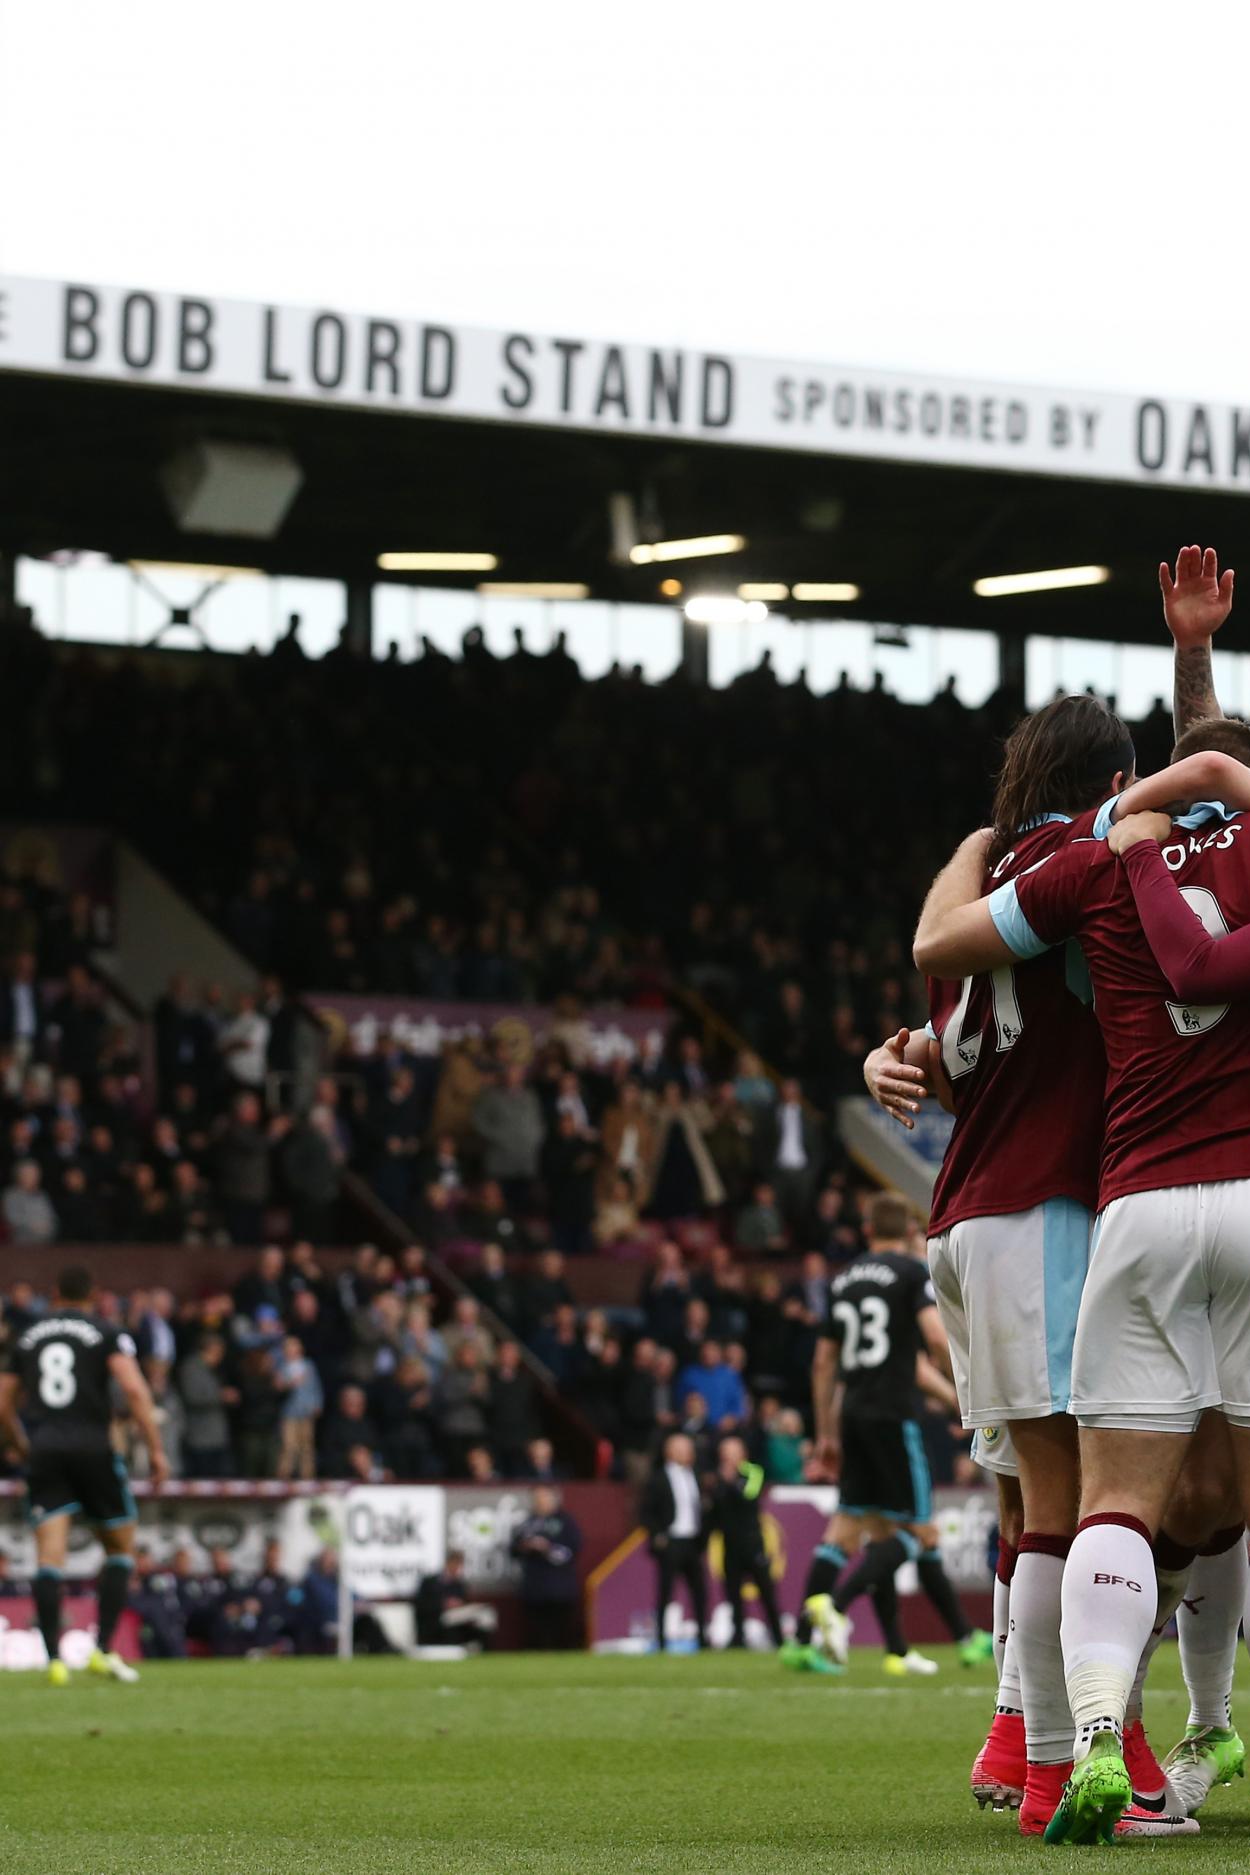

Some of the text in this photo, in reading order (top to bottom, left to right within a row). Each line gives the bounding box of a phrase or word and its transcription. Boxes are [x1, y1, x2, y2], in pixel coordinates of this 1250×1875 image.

[61, 284, 217, 379] BOB
[262, 307, 458, 402] LORD
[500, 333, 735, 430] STAND
[774, 376, 1029, 447] SPONSORED
[1048, 403, 1104, 450] BY
[1160, 824, 1243, 871] OKES
[832, 1295, 890, 1371] 23
[38, 1341, 77, 1409] 8
[348, 1500, 426, 1548] Oak
[1093, 1573, 1142, 1593] BFC
